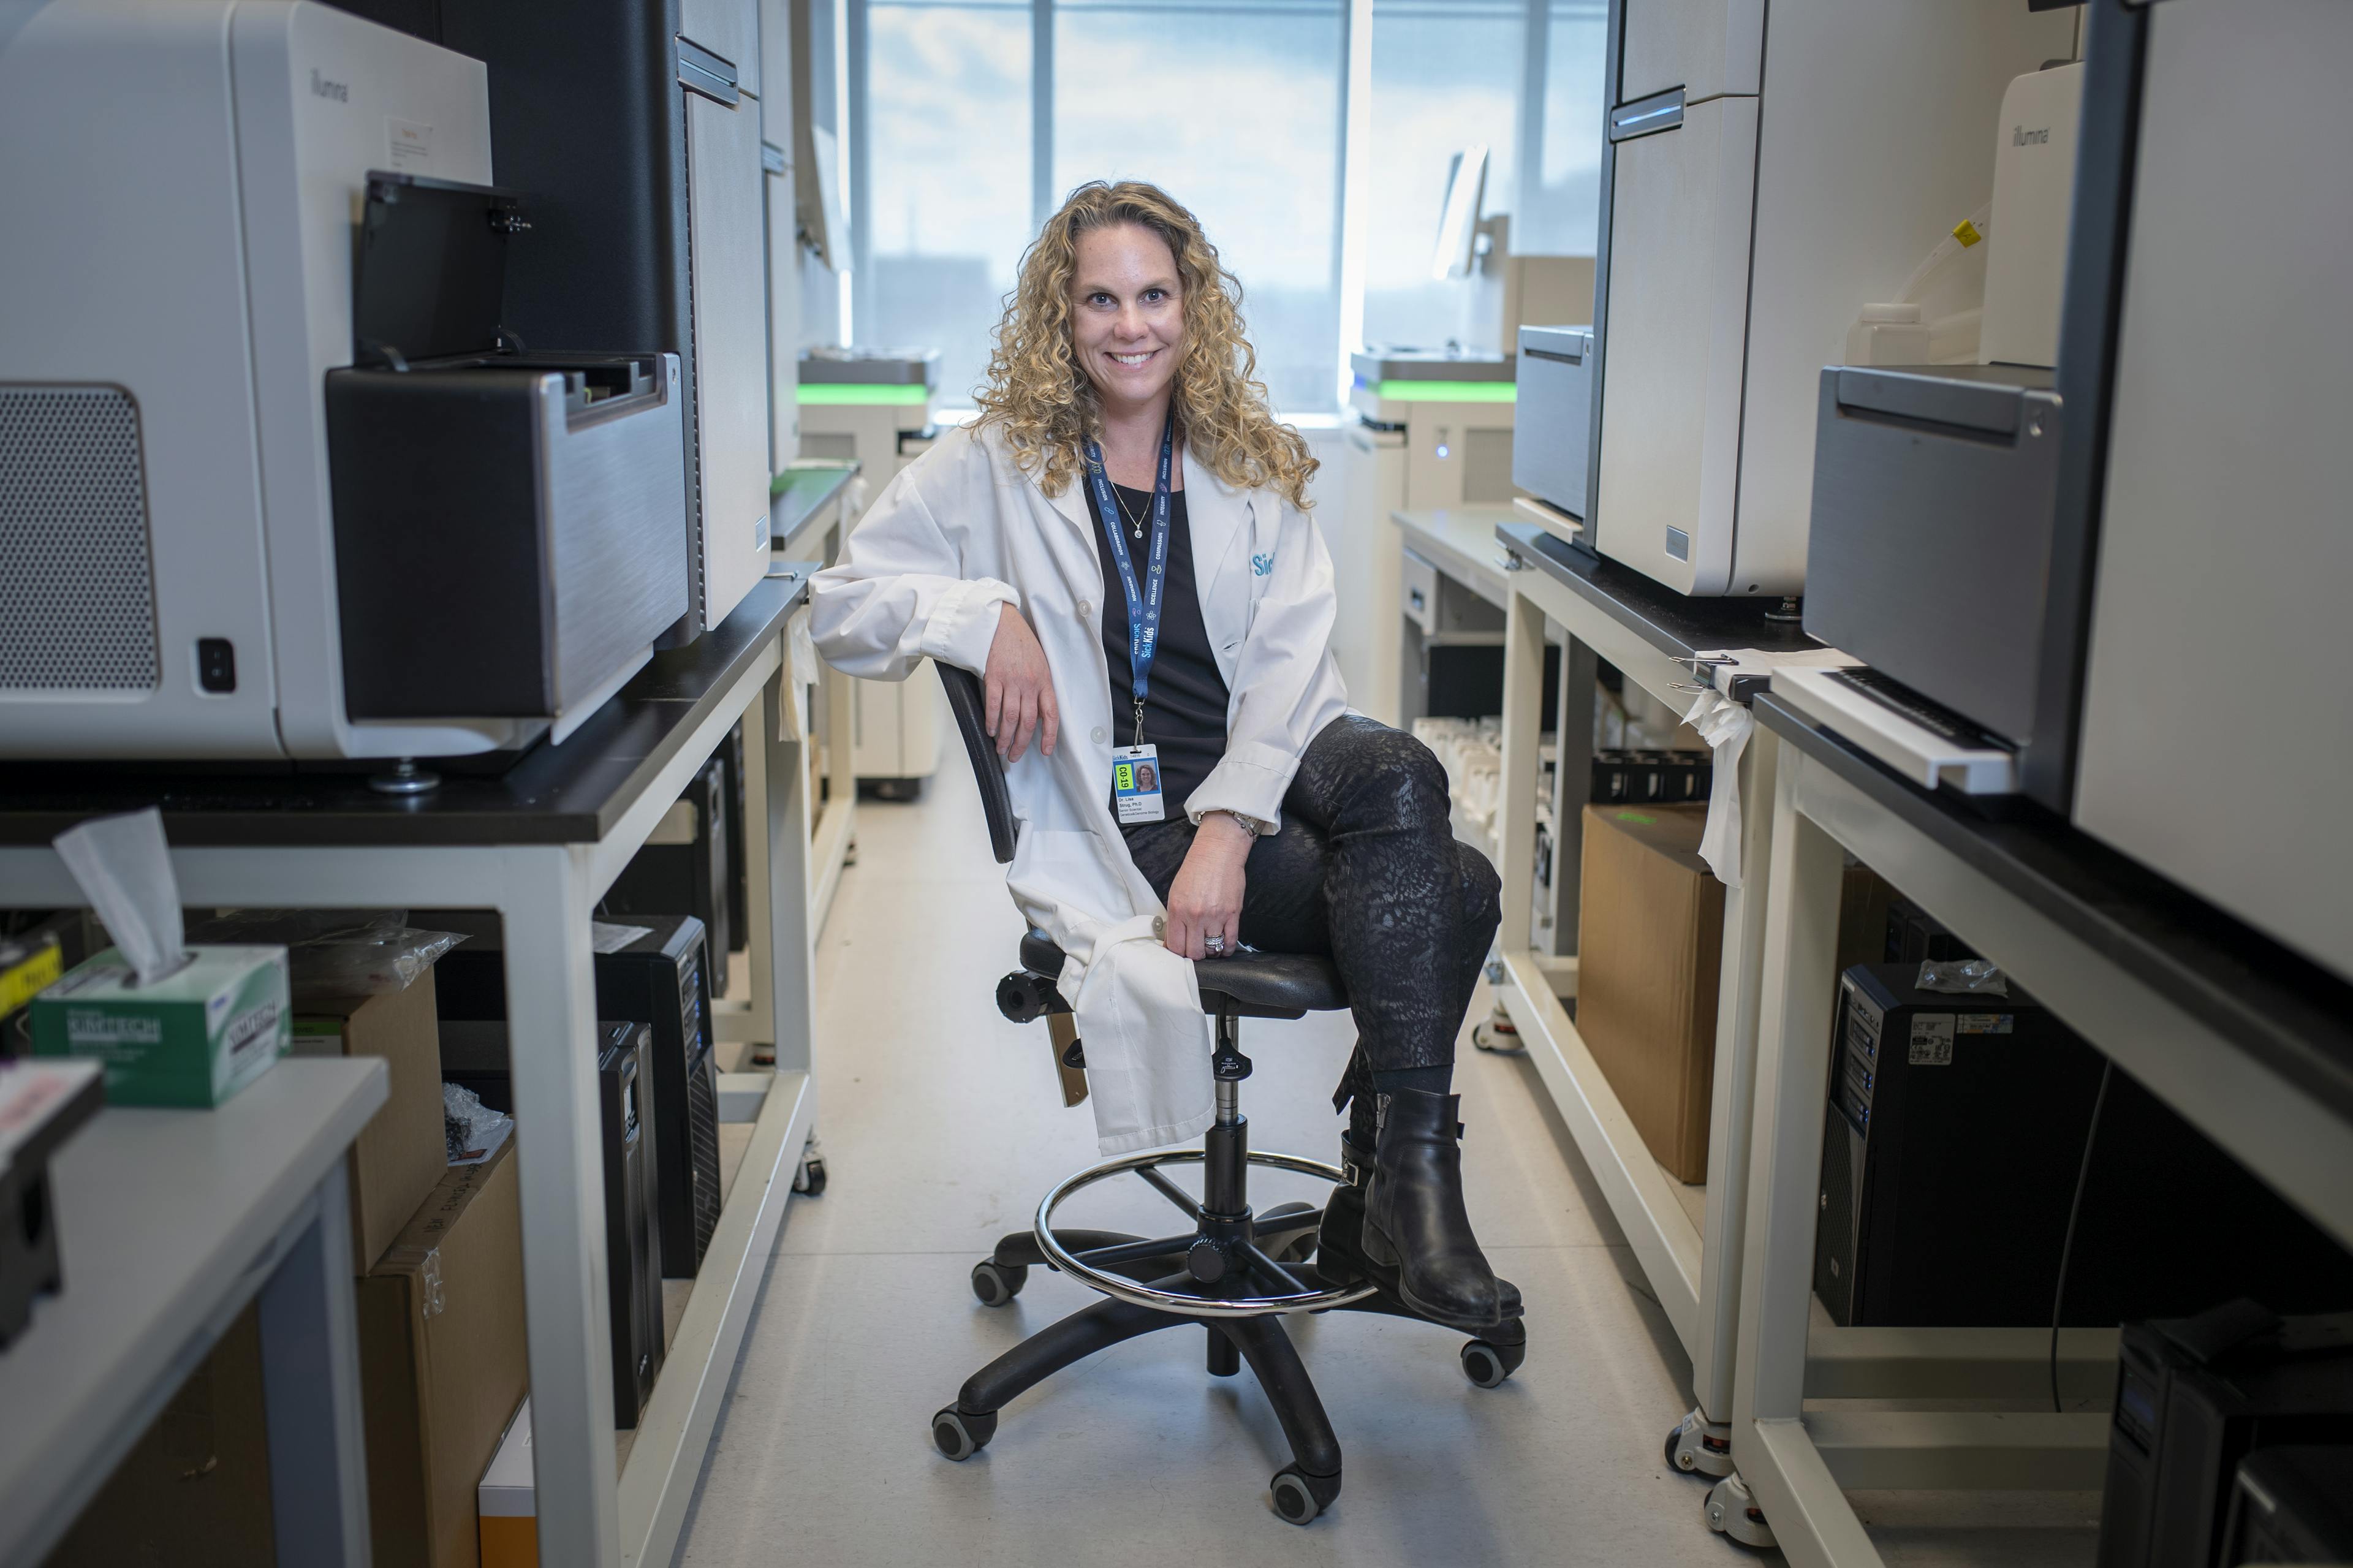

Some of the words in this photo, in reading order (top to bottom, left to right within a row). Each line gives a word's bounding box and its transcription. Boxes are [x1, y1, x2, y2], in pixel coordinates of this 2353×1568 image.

[2014, 125, 2048, 146] illumina
[1097, 479, 1108, 501] INCLUSION
[1110, 521, 1124, 555] COLLABORATION
[1252, 551, 1275, 576] Sic
[1127, 576, 1137, 601] INNOVATION
[1141, 627, 1154, 658] SickKids
